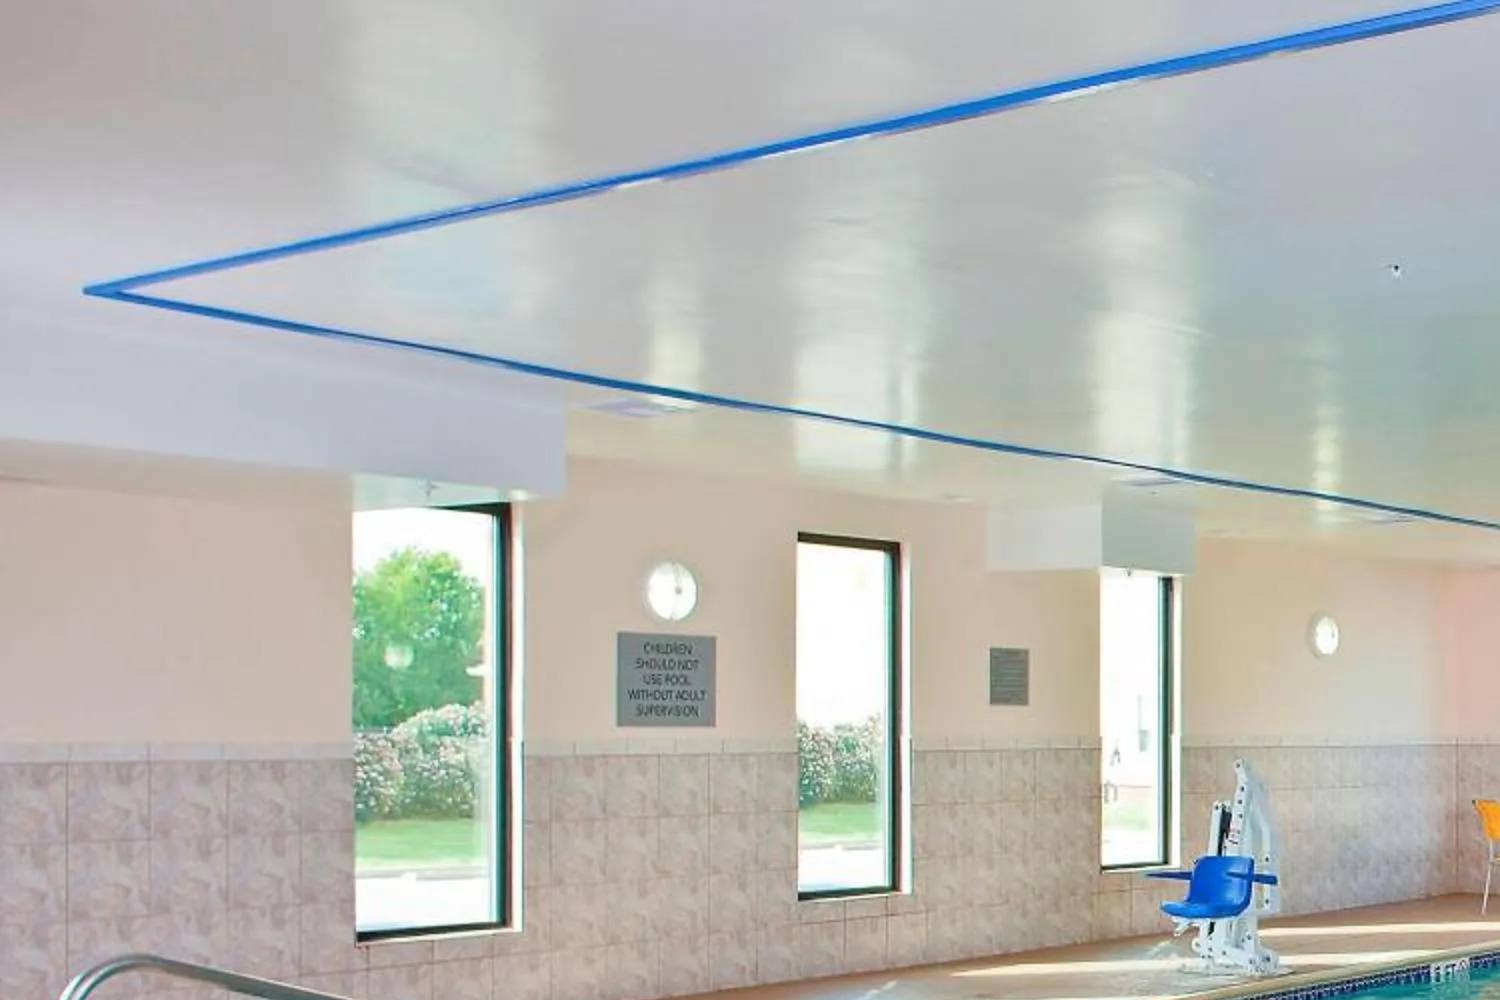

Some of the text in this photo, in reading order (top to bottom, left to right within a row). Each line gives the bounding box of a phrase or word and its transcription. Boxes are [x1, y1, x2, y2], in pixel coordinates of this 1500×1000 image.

[643, 641, 694, 655] CHILDREN
[635, 657, 700, 671] SHOULD NOT
[643, 673, 691, 686] USE POOL
[627, 688, 707, 702] WITHOUT ADULT
[636, 704, 700, 718] SUPERVISION
